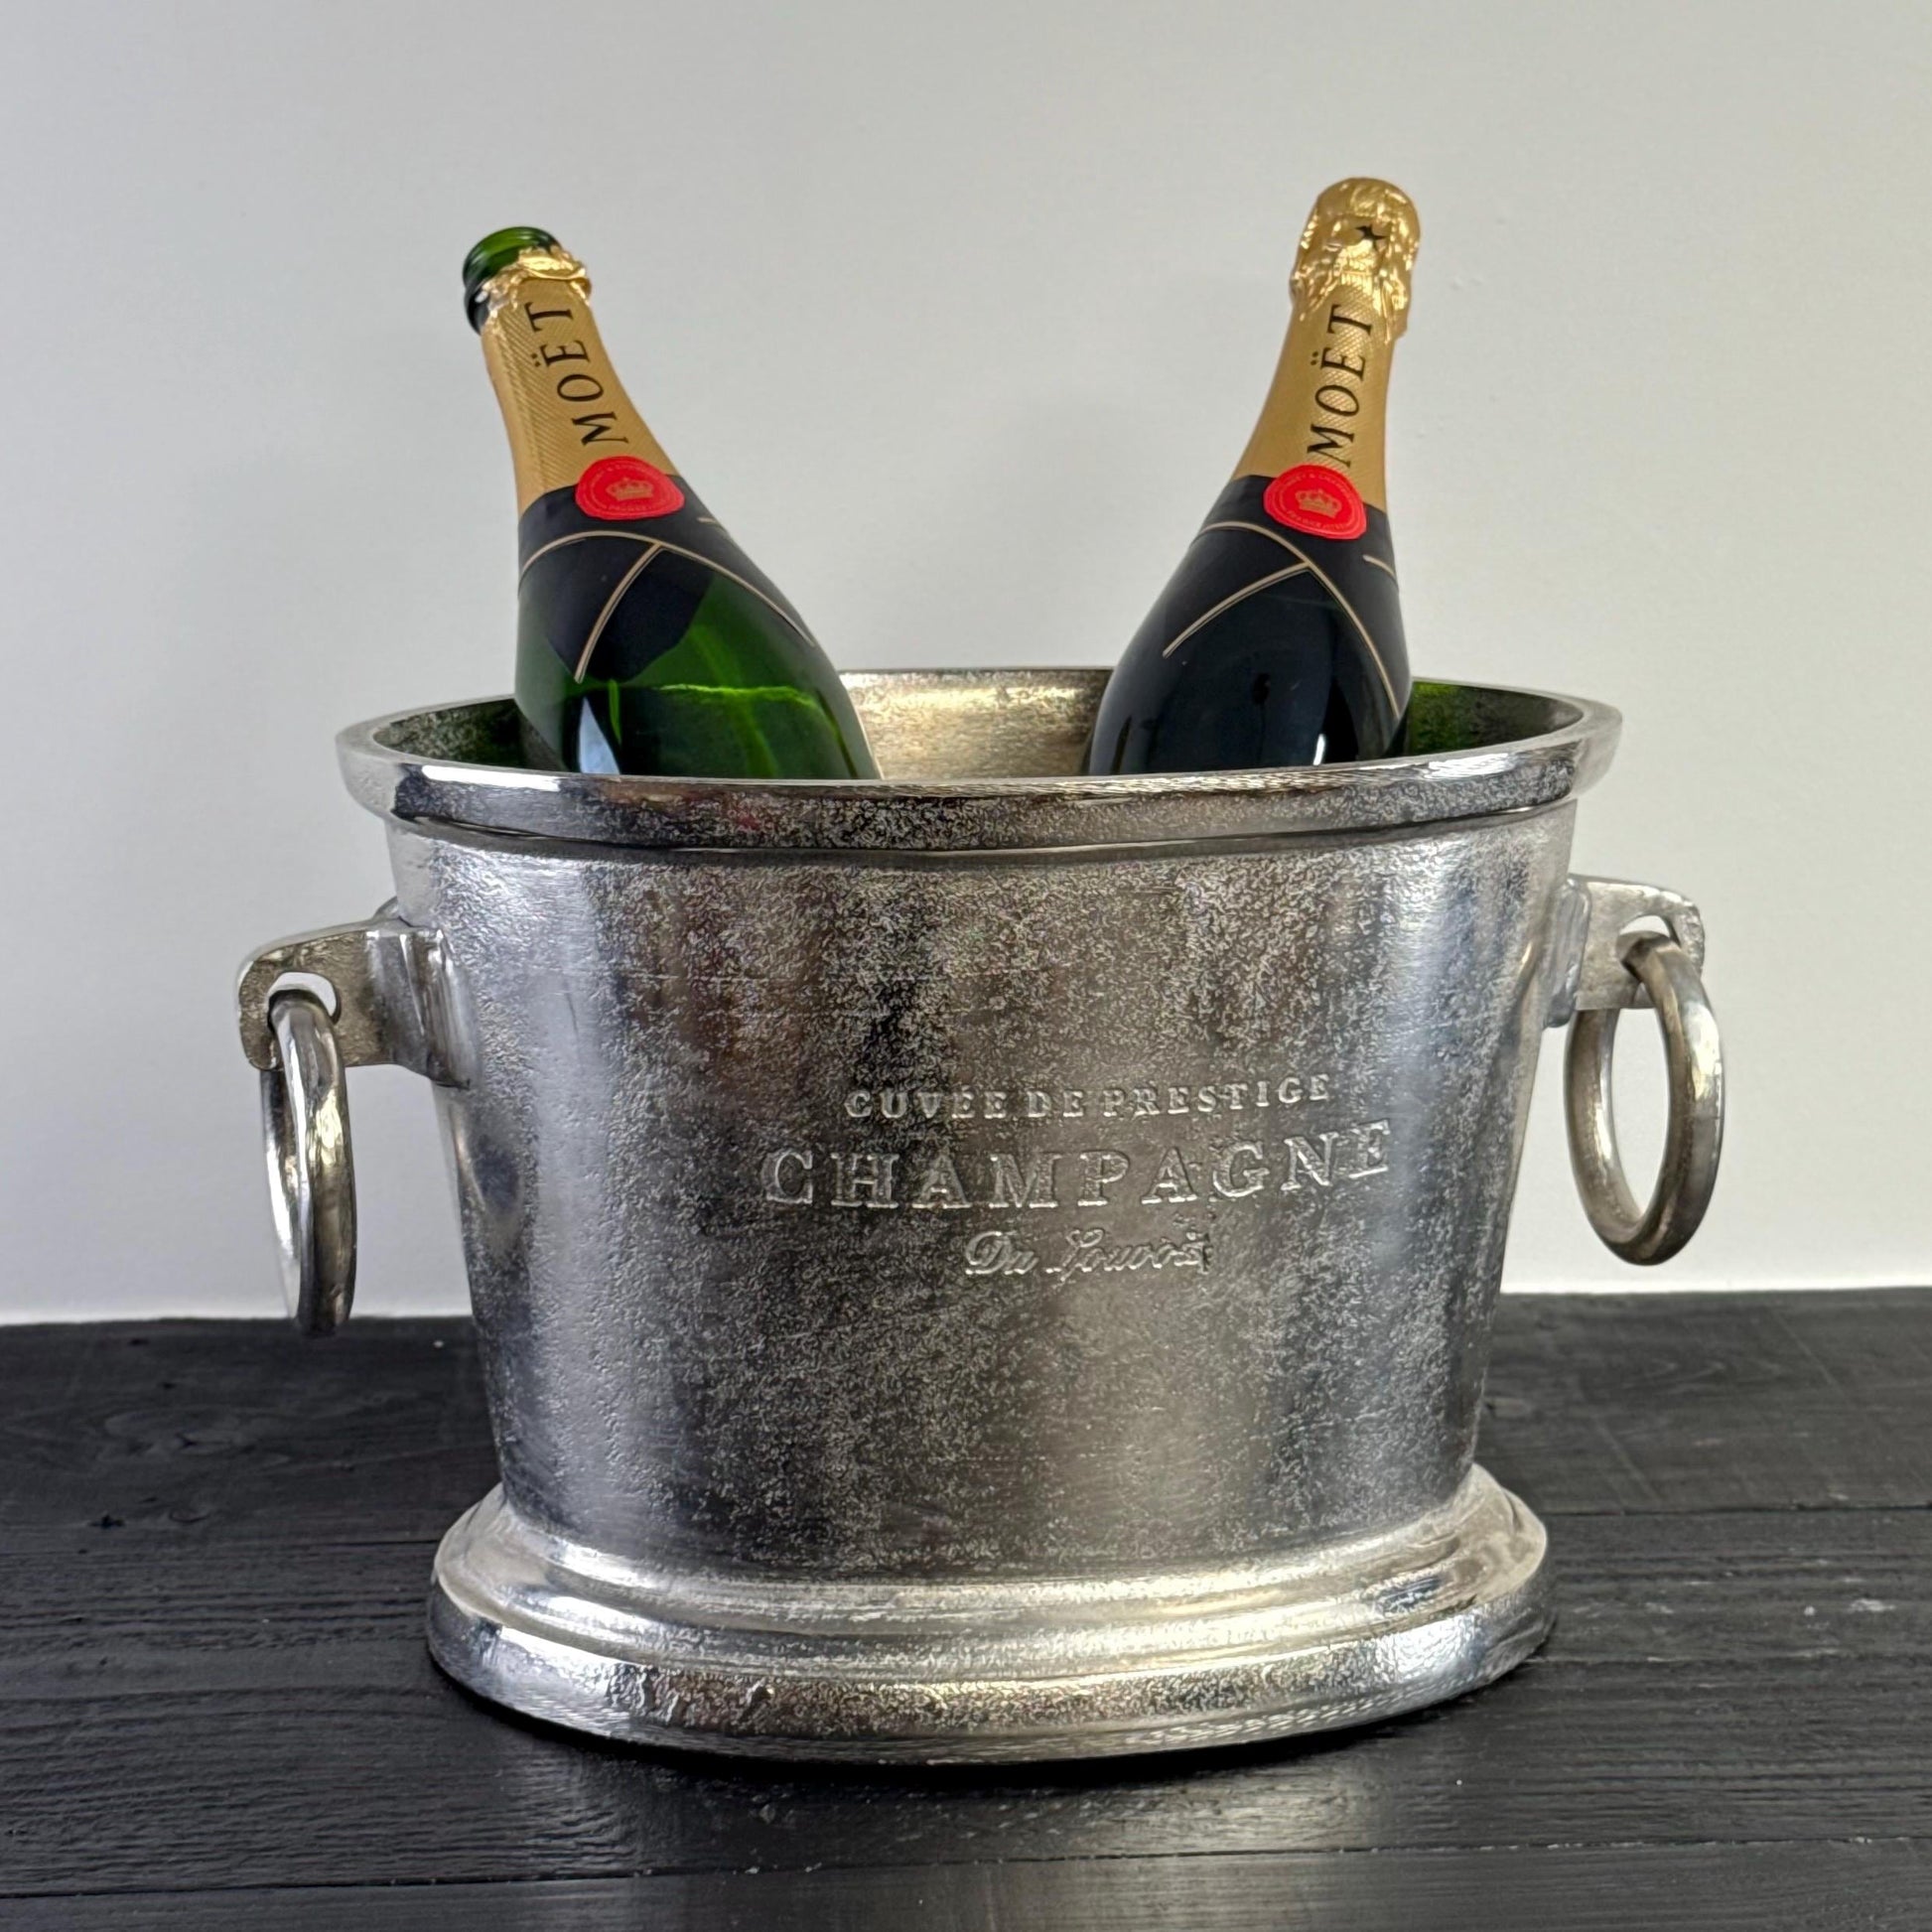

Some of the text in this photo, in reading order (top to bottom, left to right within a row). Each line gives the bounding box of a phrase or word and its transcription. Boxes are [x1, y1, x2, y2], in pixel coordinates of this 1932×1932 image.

[524, 301, 629, 447] MOËT
[1307, 303, 1373, 469] MOËT
[1028, 1089, 1083, 1118] DE
[1103, 1073, 1330, 1117] PRESTIGE
[761, 1119, 1390, 1209] CHAMPAGNE
